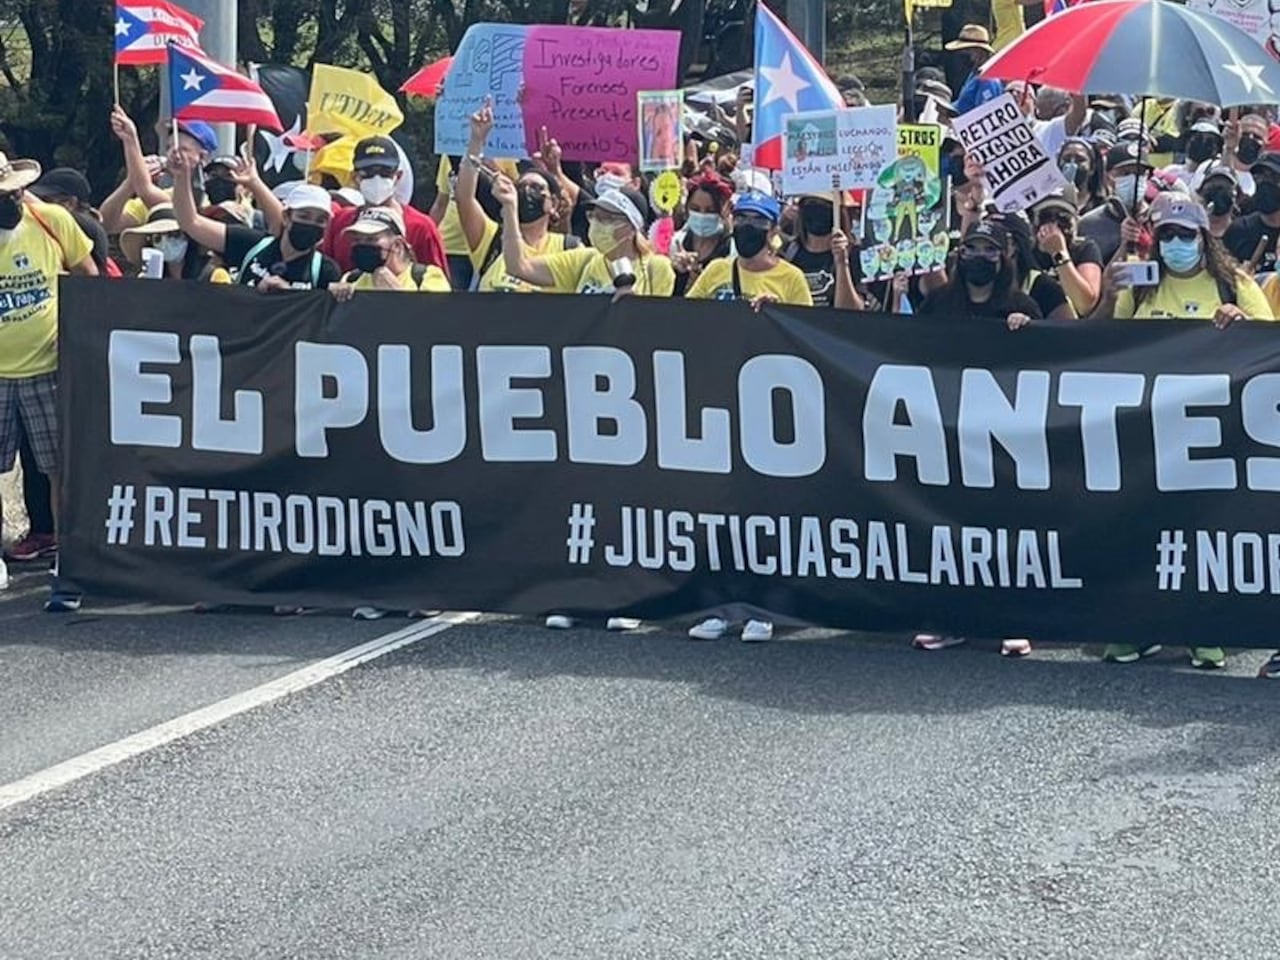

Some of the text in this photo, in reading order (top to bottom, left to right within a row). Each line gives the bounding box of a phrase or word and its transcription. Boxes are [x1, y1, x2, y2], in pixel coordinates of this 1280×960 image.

[533, 38, 660, 76] Investigadores
[560, 76, 629, 97] Forenses
[897, 129, 936, 145] STROS
[960, 102, 1019, 148] RETIRO
[985, 144, 1044, 190] AHORA
[108, 329, 263, 455] EL
[295, 341, 826, 478] PUEBLO
[105, 484, 466, 557] #RETIRODIGNO
[567, 503, 1083, 589] #JUSTICIASALARIAL
